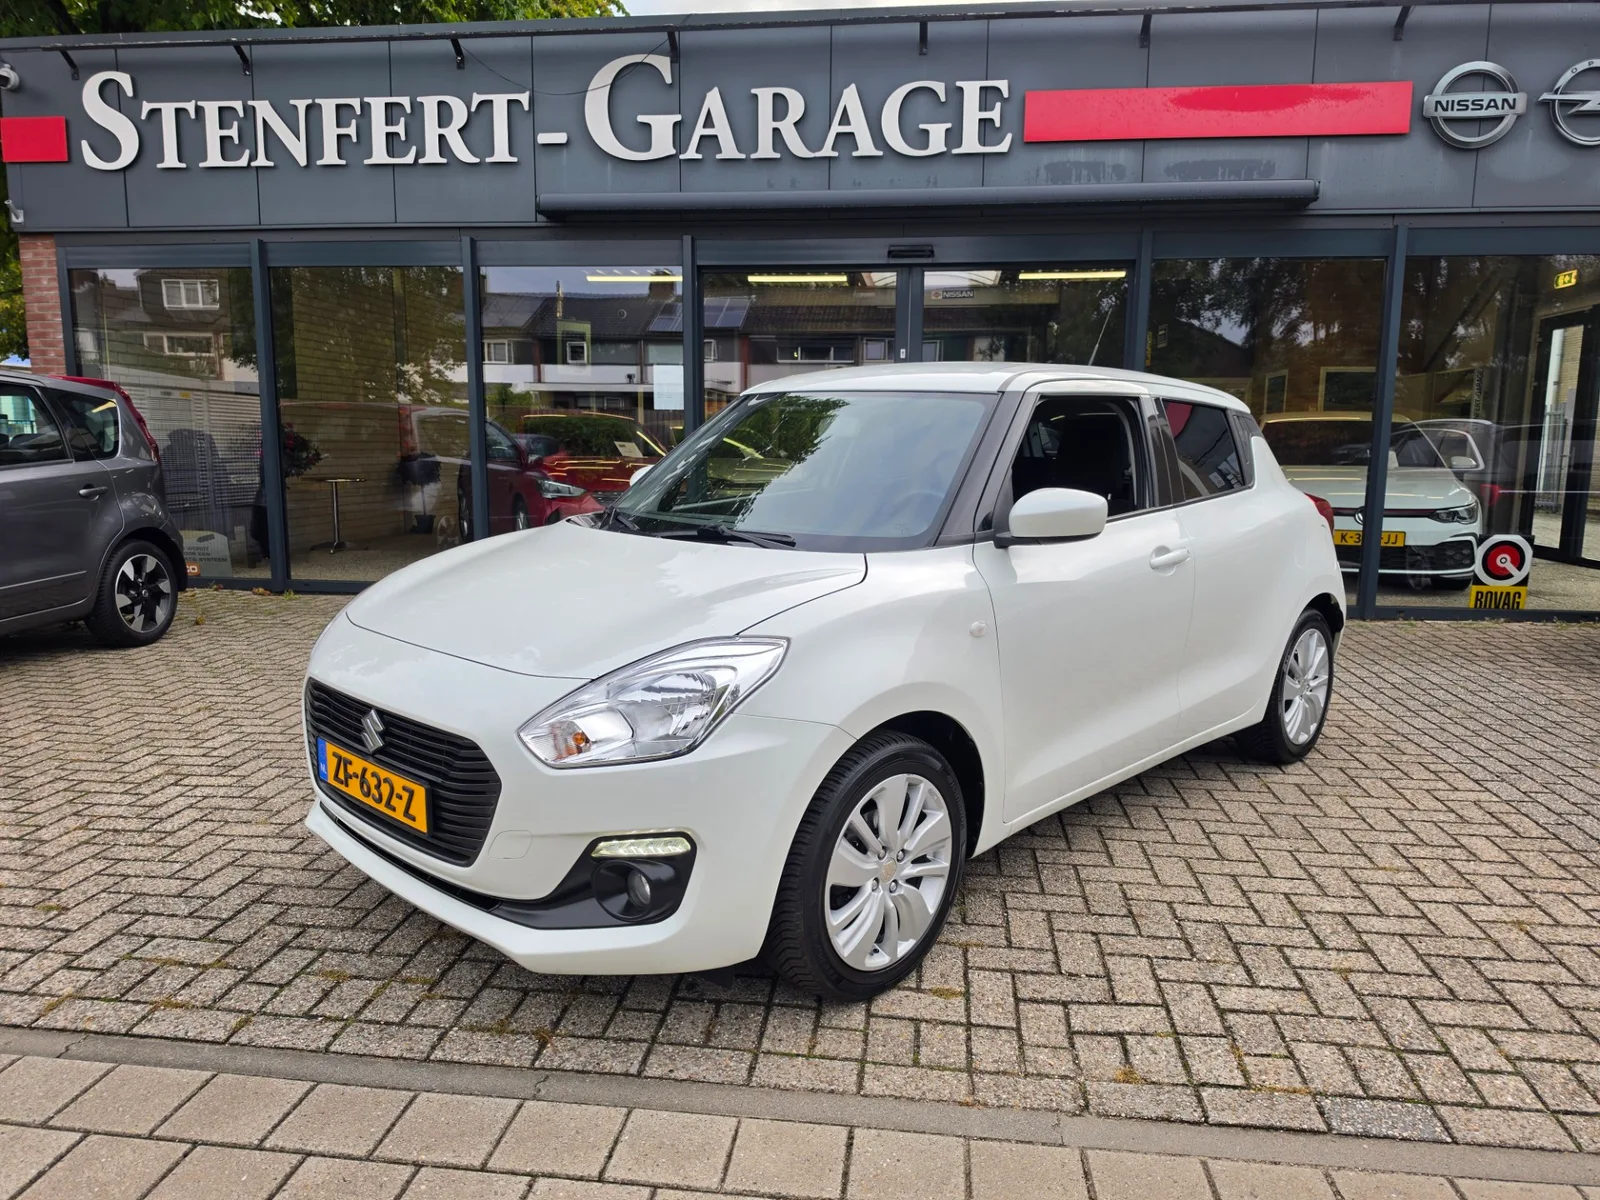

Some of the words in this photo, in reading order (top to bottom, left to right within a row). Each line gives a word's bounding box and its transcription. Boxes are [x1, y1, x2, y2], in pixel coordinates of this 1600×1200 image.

[80, 52, 1013, 171] STENFERT-GARAGE
[1434, 98, 1517, 113] NISSAN
[1340, 532, 1398, 545] K-3-JJ
[1474, 590, 1522, 610] BOVAG
[332, 751, 417, 823] ZF-632-Z
